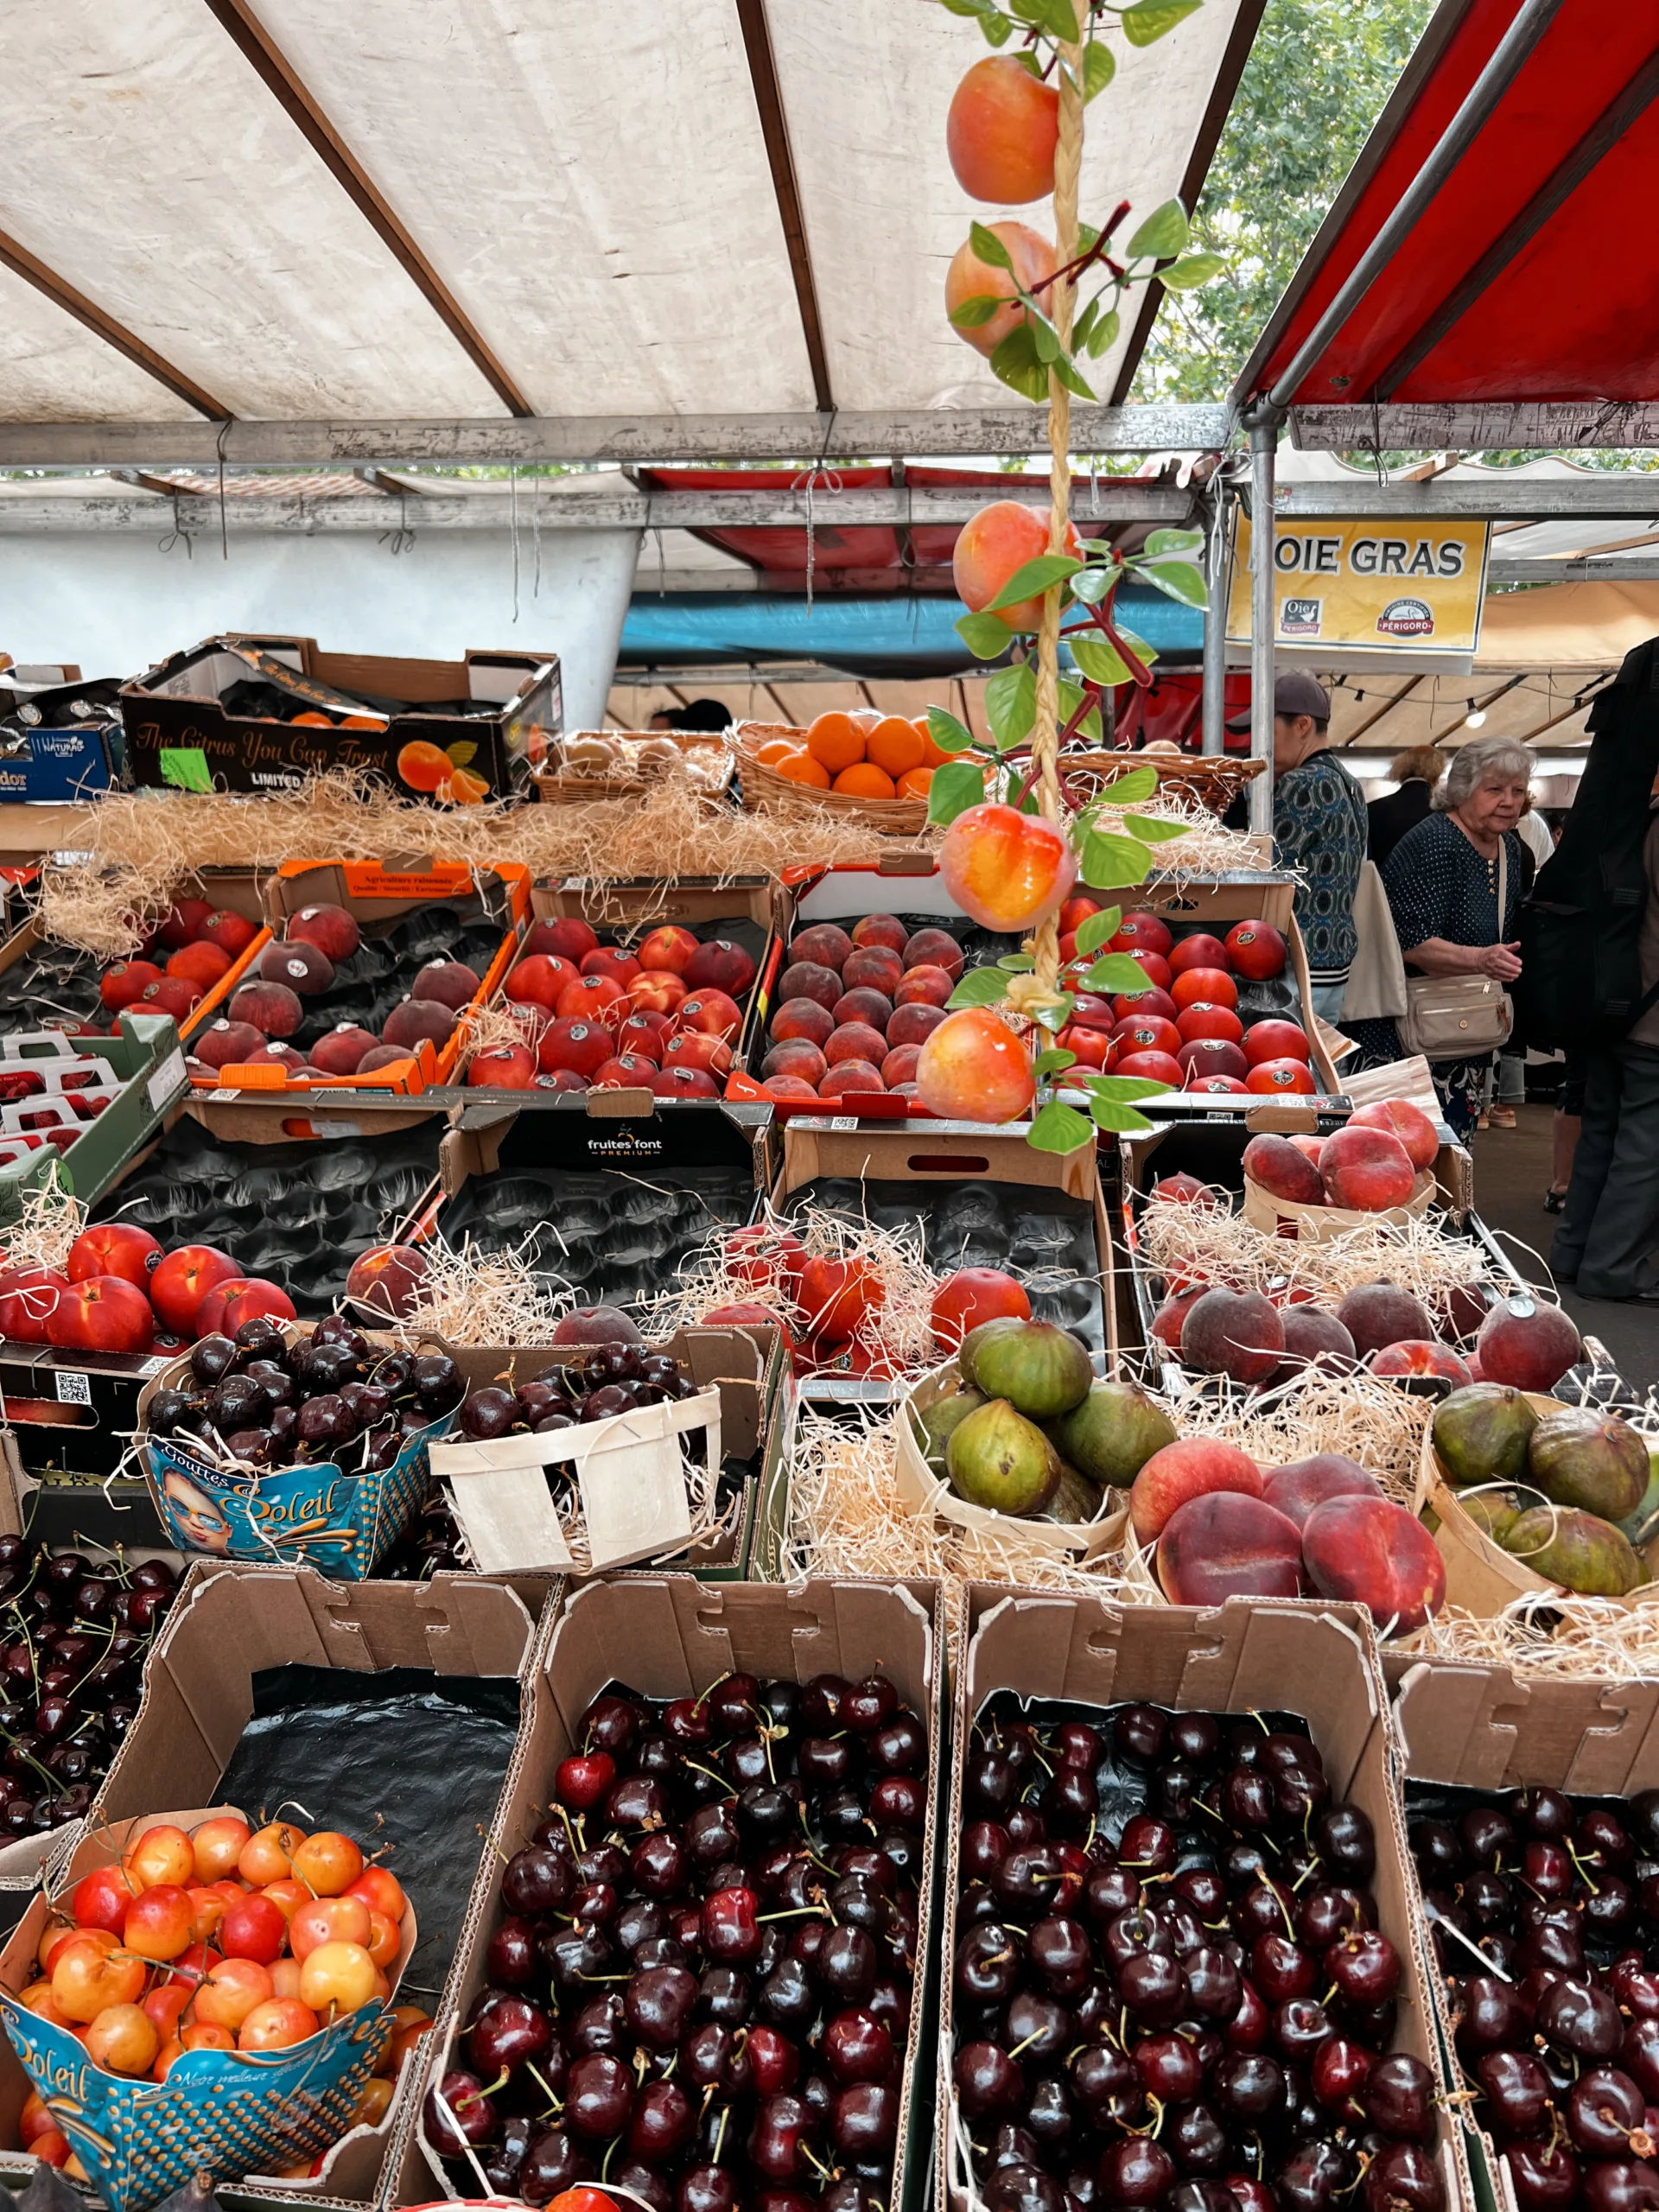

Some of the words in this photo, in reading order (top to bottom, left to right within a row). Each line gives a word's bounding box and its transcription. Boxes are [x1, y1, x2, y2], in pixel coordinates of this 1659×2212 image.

[1249, 536, 1340, 575] OIE
[1351, 540, 1463, 576] GRAS
[1287, 601, 1310, 613] Oie
[1382, 621, 1428, 631] PÉRIGORD
[136, 722, 173, 749] The
[181, 726, 235, 757] Citrus
[242, 731, 283, 768] You
[289, 736, 327, 763] Can
[336, 740, 388, 768] Trust
[250, 772, 301, 788] LIMITED
[365, 876, 411, 885] Agriculture
[588, 1140, 632, 1149] fruites
[634, 1140, 662, 1149] font
[161, 1446, 229, 1486] Gouttes
[219, 1480, 341, 1522] Soleil
[180, 2071, 213, 2086] Notre
